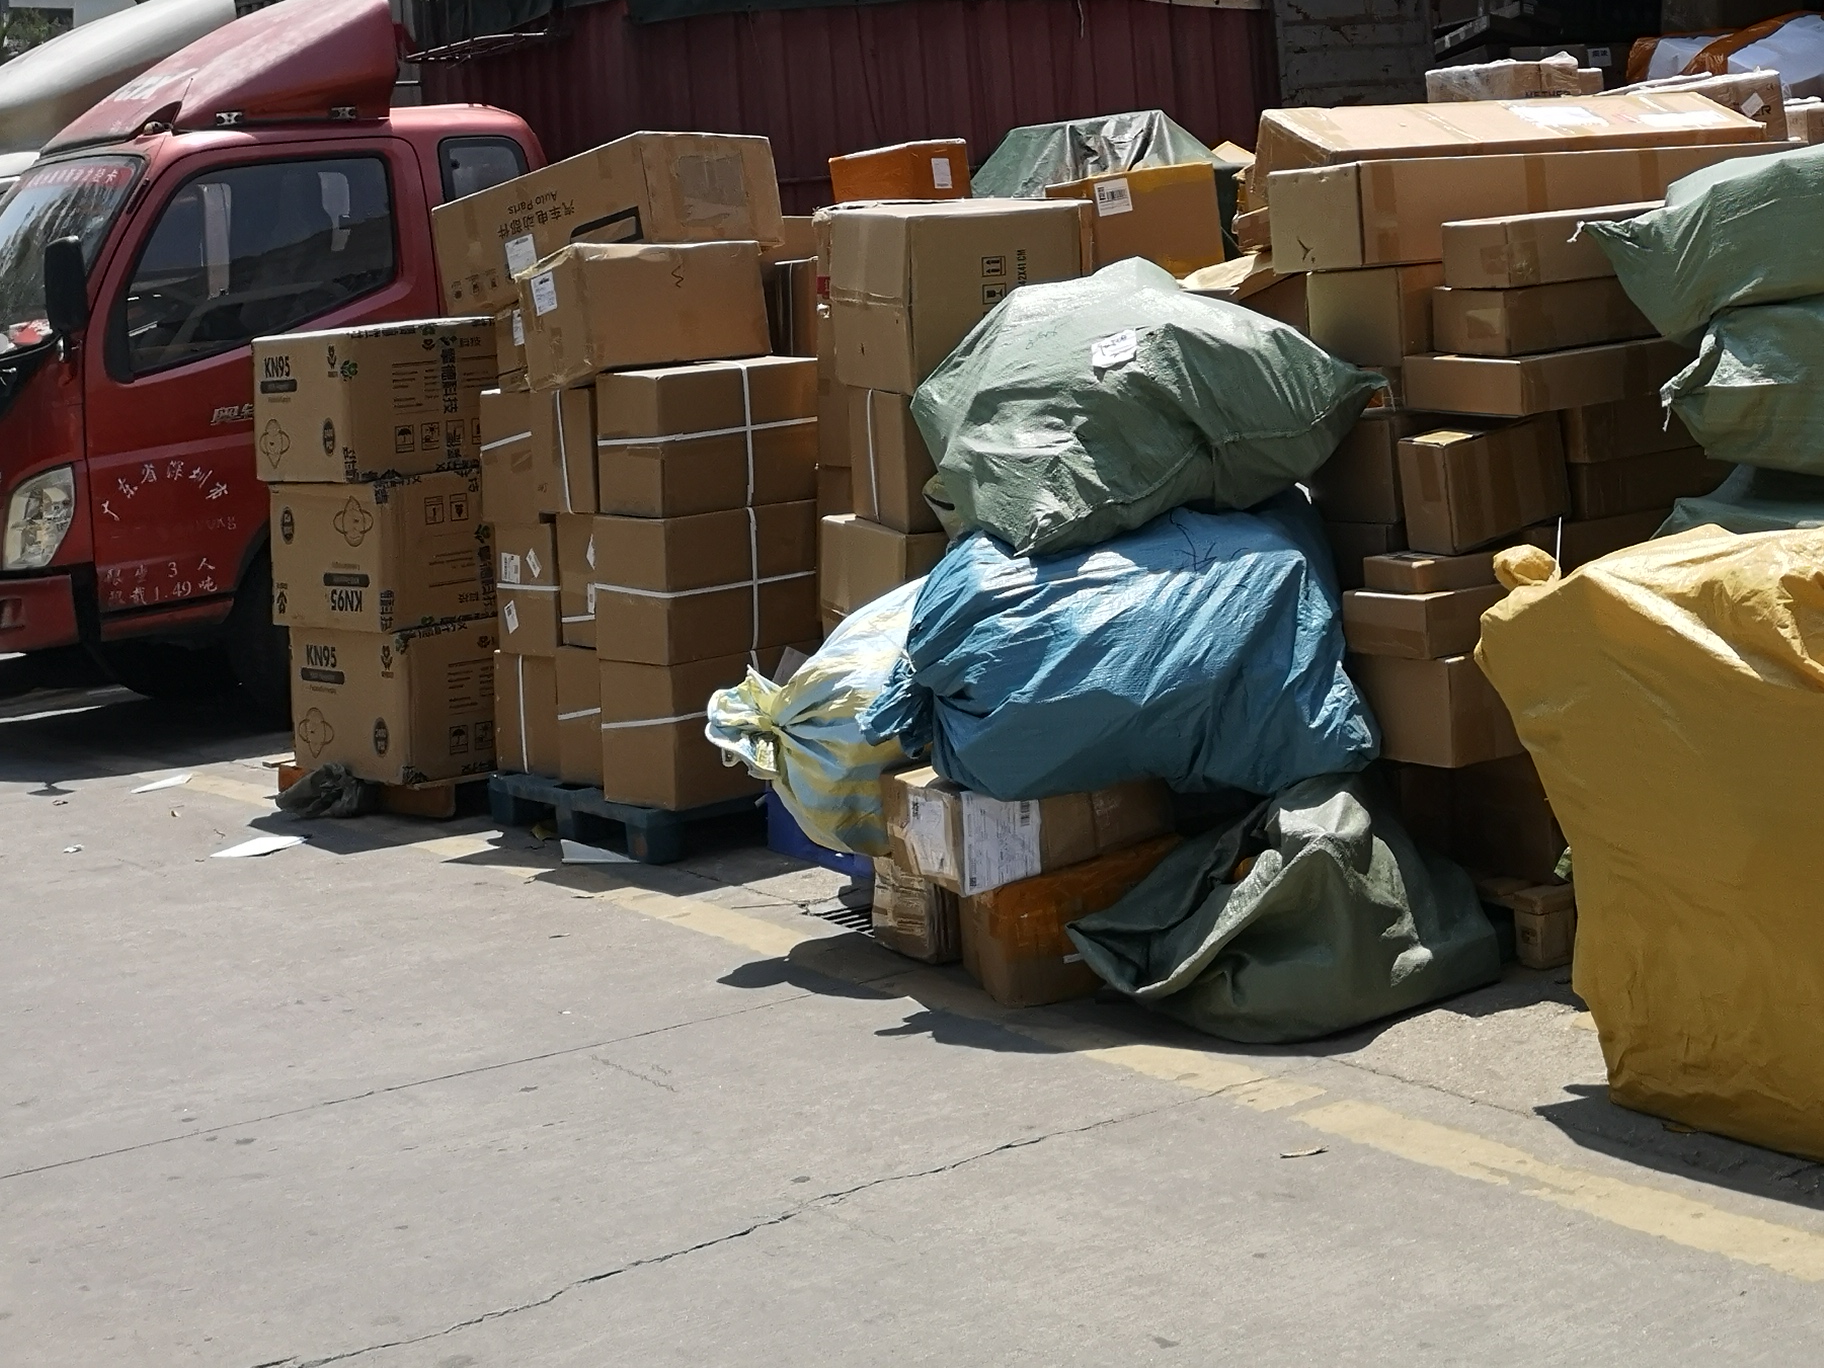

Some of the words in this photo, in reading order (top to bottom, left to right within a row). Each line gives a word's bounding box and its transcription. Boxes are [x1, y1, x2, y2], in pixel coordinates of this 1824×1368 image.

[507, 199, 534, 215] Parts
[535, 190, 558, 206] Auto
[1017, 249, 1026, 262] CM
[264, 355, 291, 378] KN95
[330, 589, 363, 613] KN95
[306, 643, 337, 668] KN95
